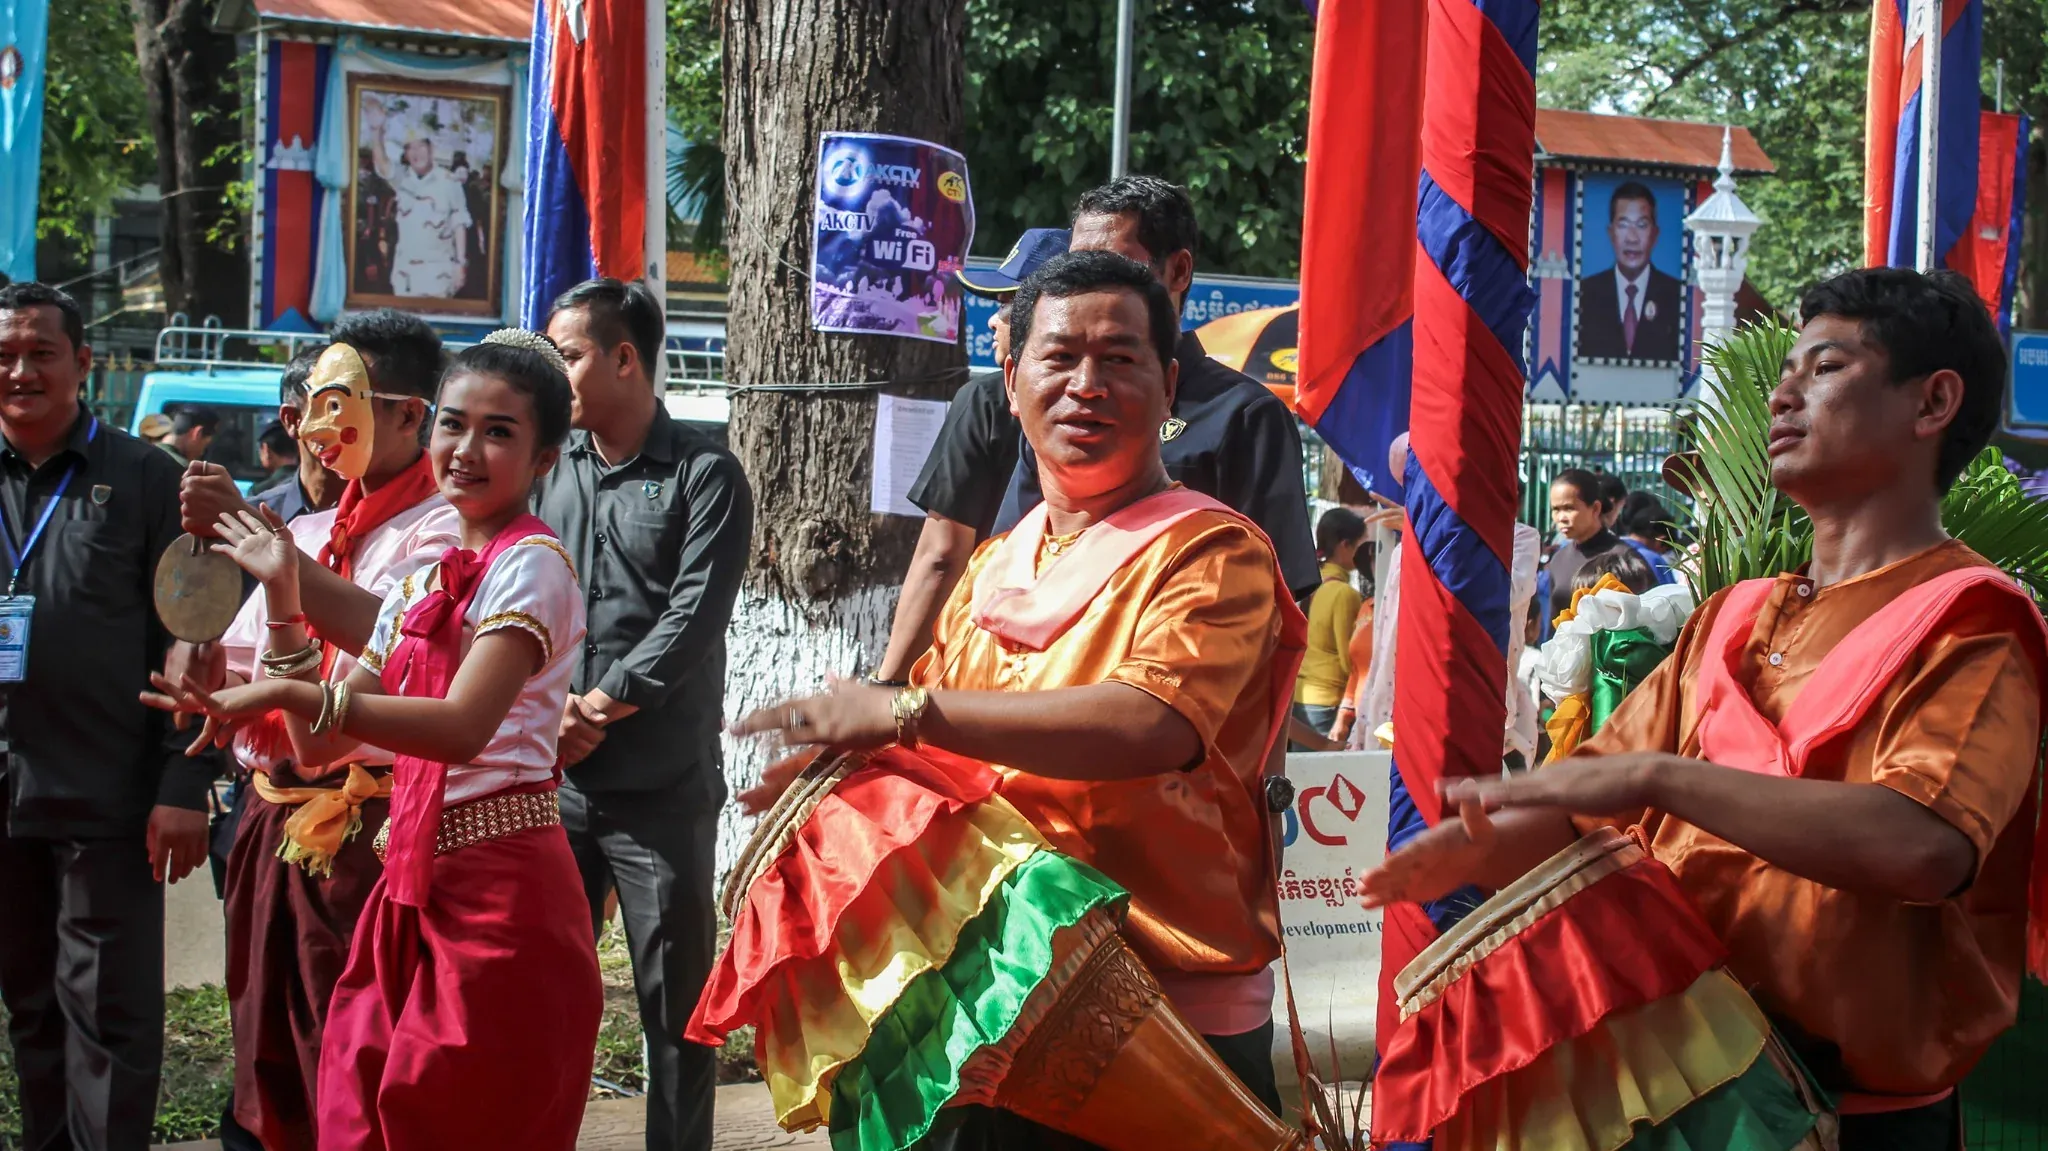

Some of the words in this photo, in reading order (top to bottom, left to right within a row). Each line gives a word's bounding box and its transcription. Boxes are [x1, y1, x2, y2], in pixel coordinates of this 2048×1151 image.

[864, 163, 921, 182] AKCTV
[821, 212, 875, 232] AKCTV
[895, 228, 917, 239] Free
[1281, 920, 1373, 939] evelopment
